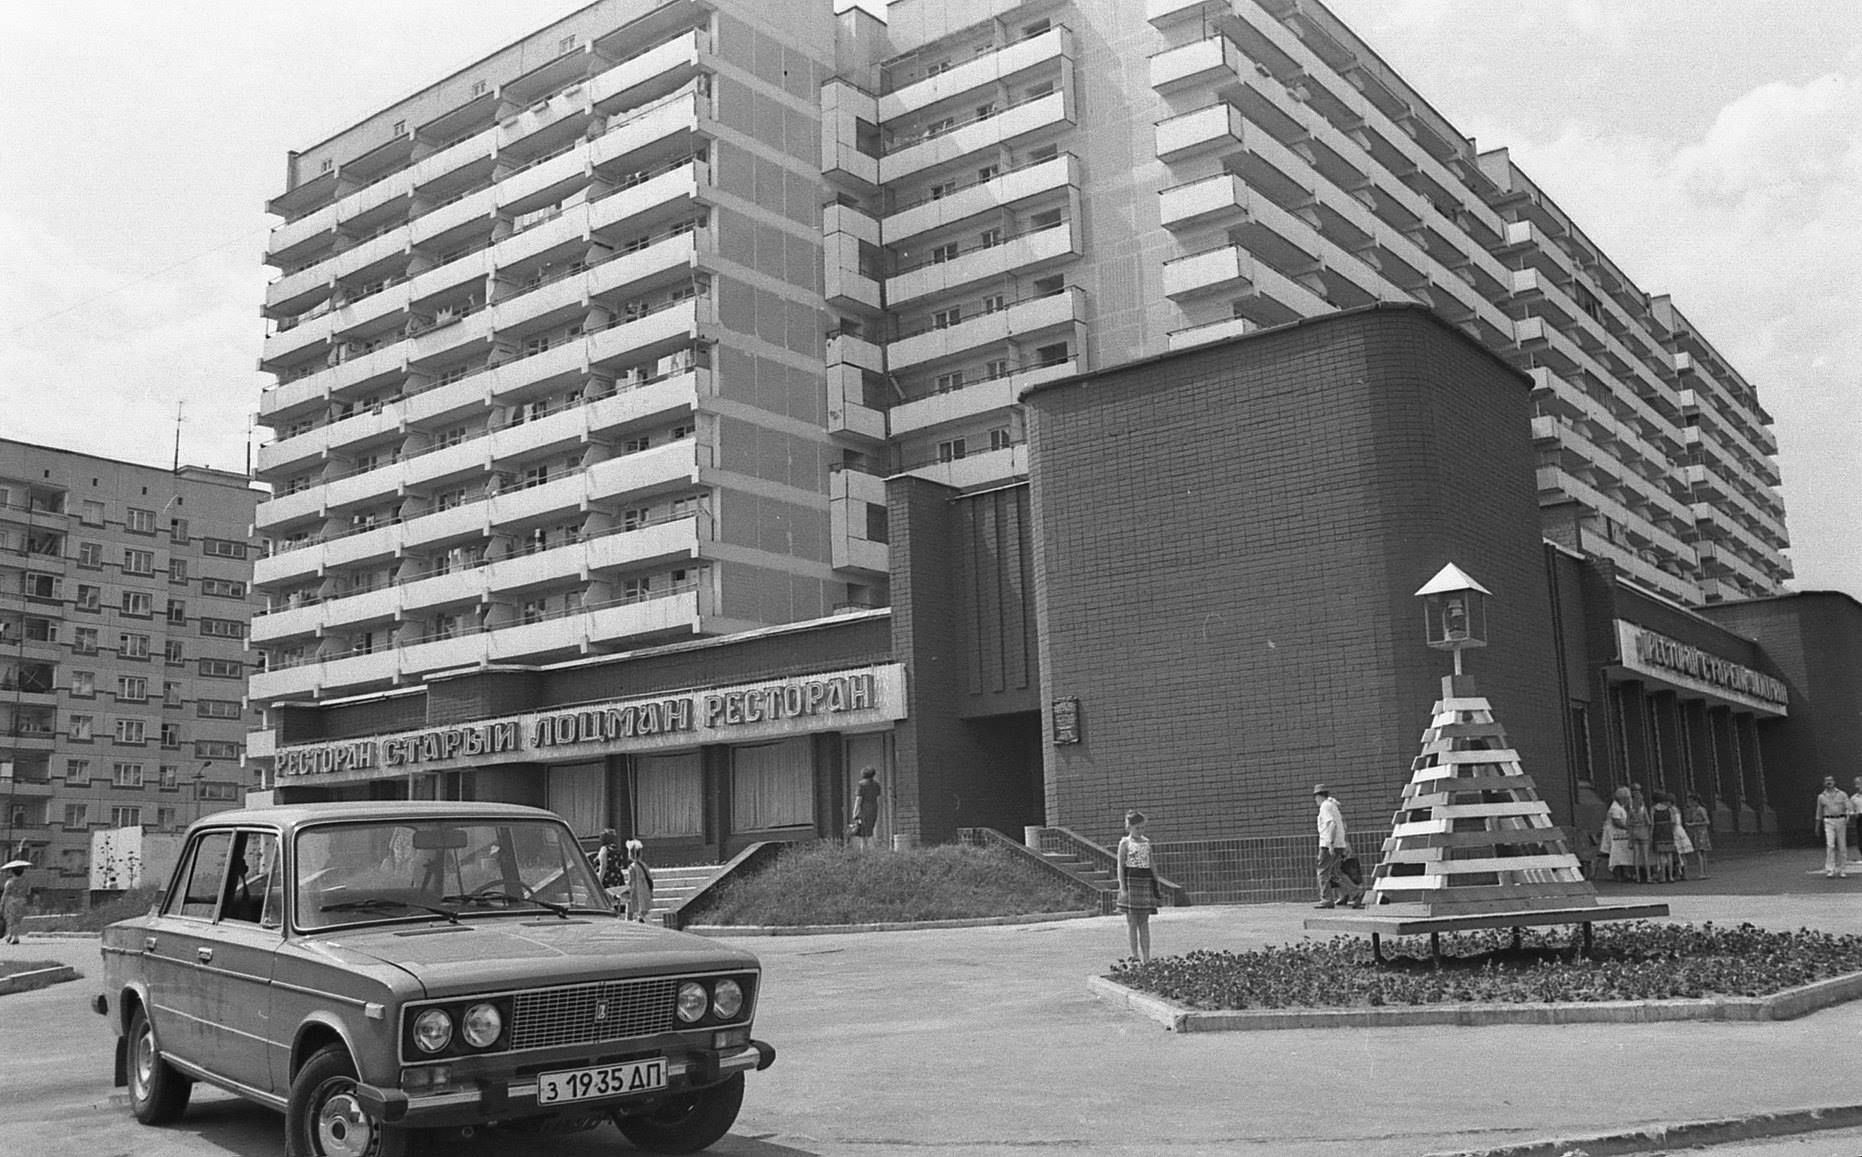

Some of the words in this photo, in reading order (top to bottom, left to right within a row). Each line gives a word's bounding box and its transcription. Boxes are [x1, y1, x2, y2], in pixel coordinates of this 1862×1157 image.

[275, 741, 376, 777] РЕСТОРАН
[531, 698, 692, 749] ЛОЦМАН
[704, 674, 874, 728] РЕСТОРАН
[628, 1062, 662, 1091] ДП
